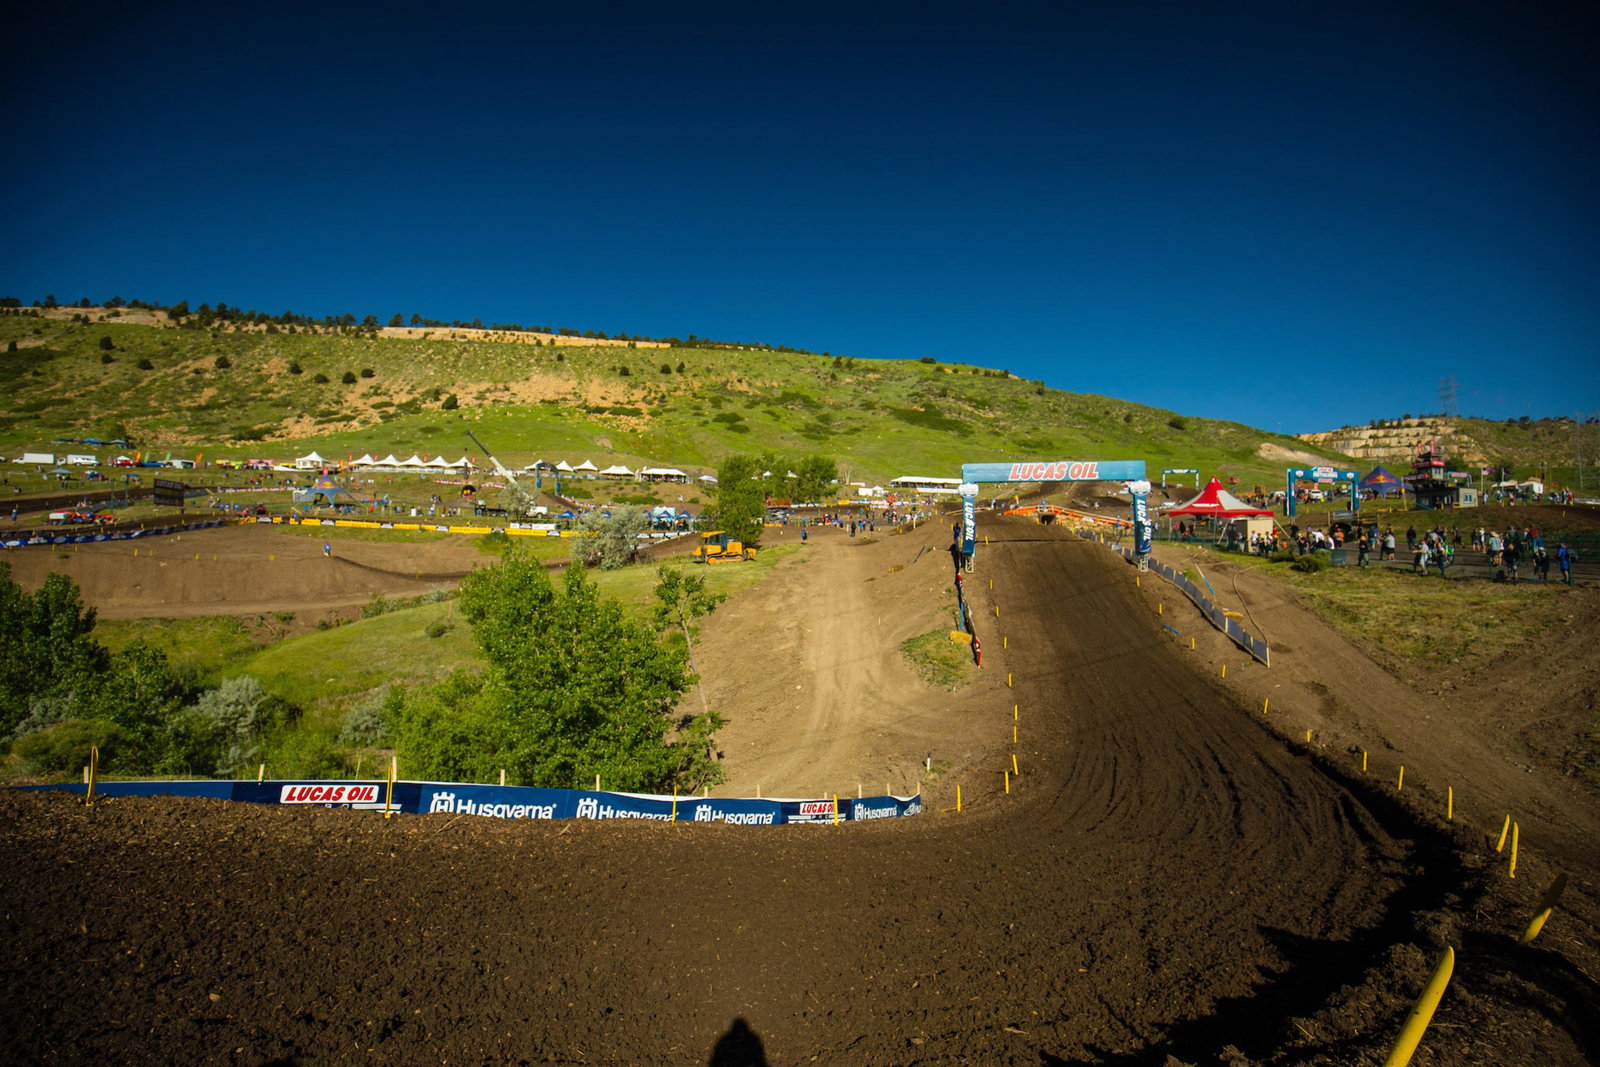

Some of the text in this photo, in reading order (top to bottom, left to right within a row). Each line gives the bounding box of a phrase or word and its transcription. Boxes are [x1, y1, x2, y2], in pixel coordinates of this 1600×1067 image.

[1009, 462, 1099, 480] LUCAS OIL
[965, 527, 975, 541] OIL
[1143, 527, 1152, 541] OIL
[285, 787, 375, 801] LUCAS OIL
[456, 799, 554, 819] Husqvarna
[802, 803, 827, 813] LUCAS
[864, 806, 897, 819] Husqvarna
[712, 809, 773, 825] Husqvarna
